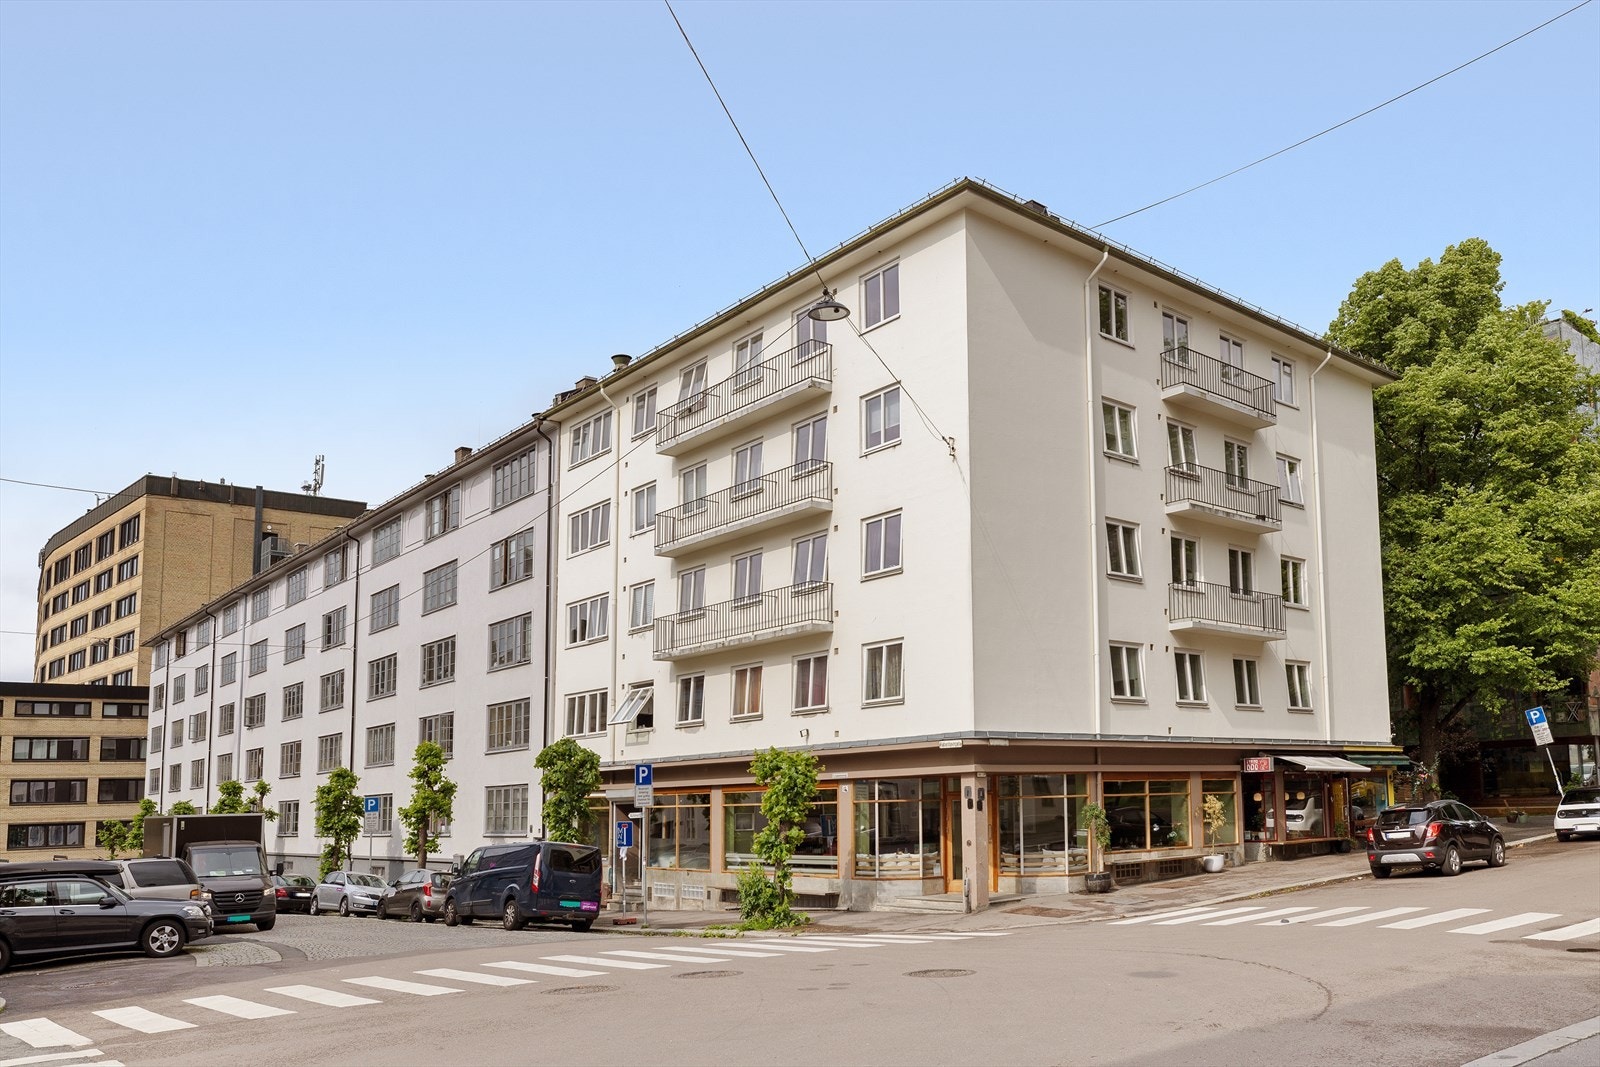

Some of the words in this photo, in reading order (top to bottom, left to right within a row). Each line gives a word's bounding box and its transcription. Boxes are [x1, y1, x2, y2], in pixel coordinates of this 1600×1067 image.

[1529, 710, 1540, 723] P
[639, 766, 649, 783] P
[367, 799, 376, 811] P
